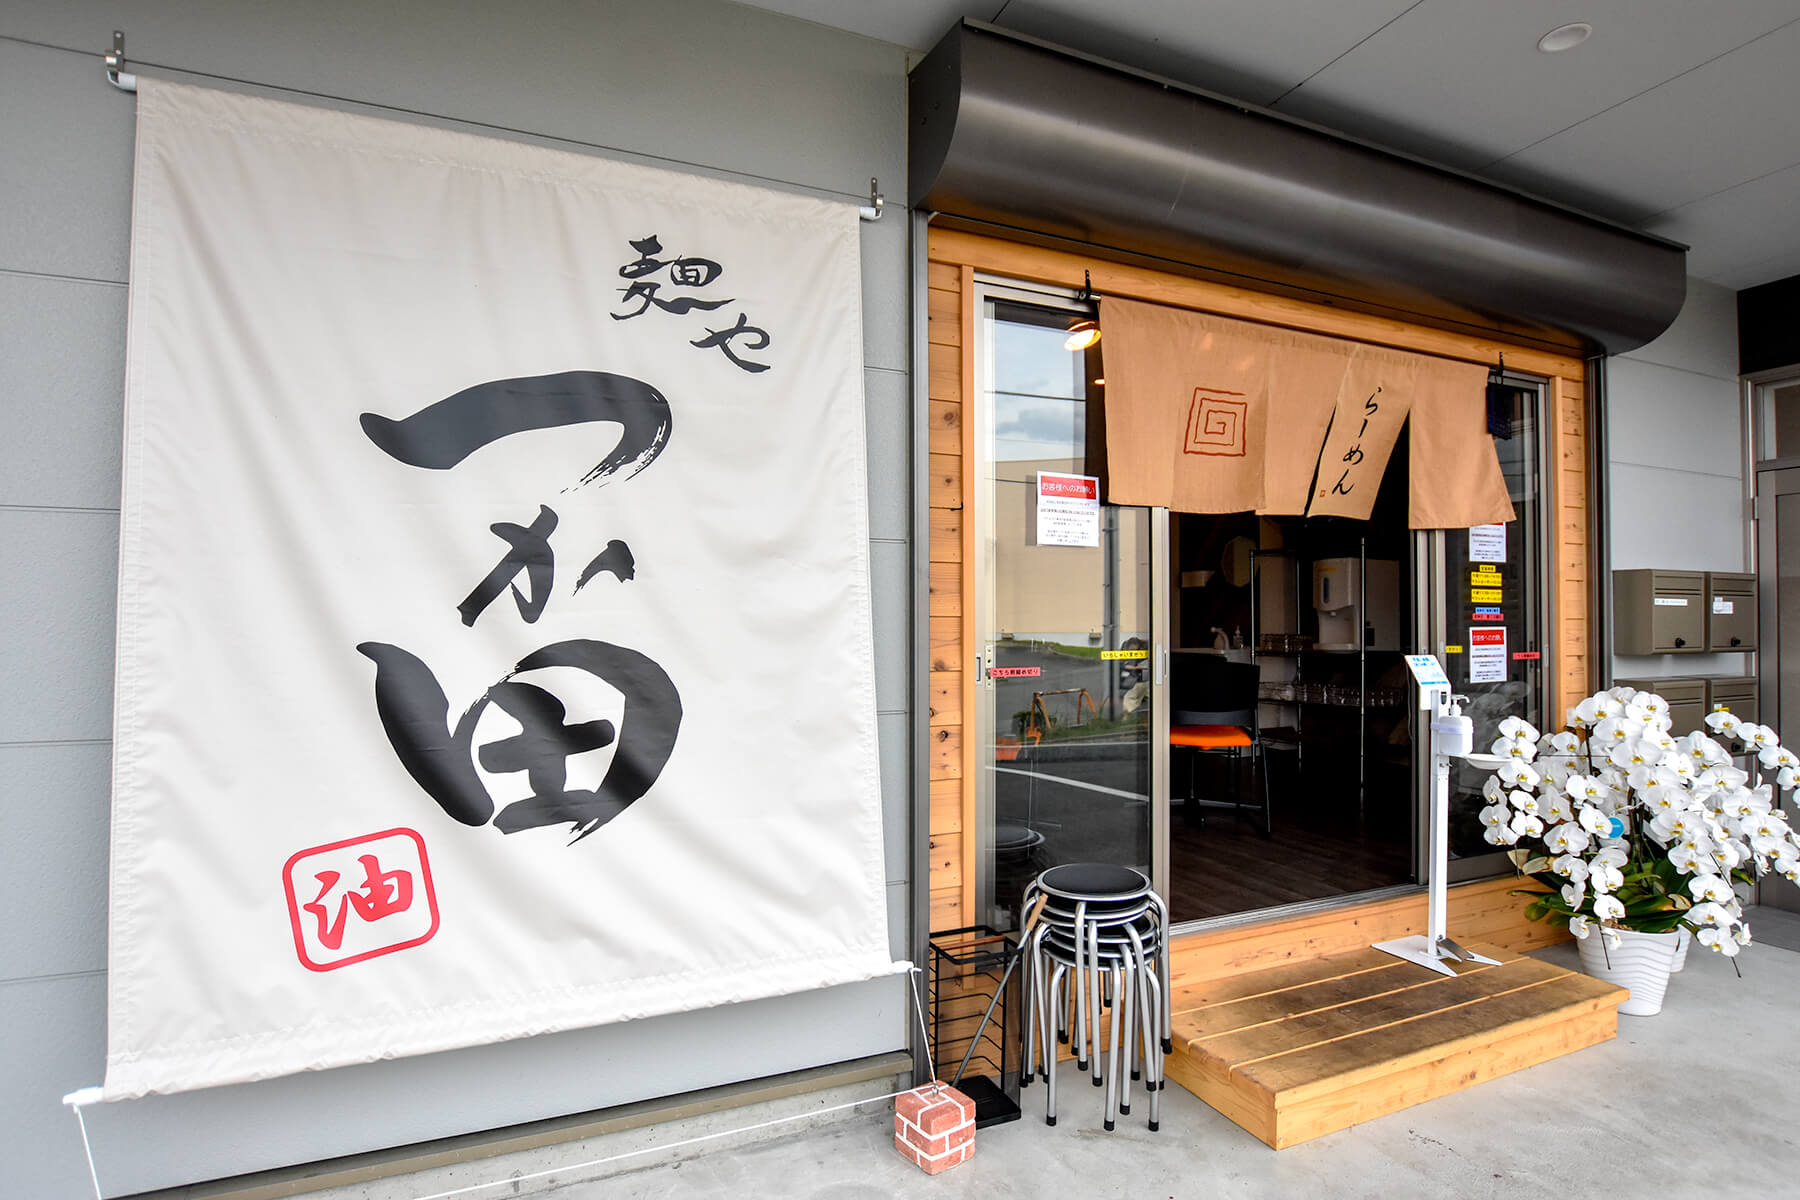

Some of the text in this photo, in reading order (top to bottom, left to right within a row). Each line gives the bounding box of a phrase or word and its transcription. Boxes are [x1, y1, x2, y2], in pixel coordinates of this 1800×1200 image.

[1331, 386, 1383, 496] らーめん
[303, 855, 413, 949] 油
